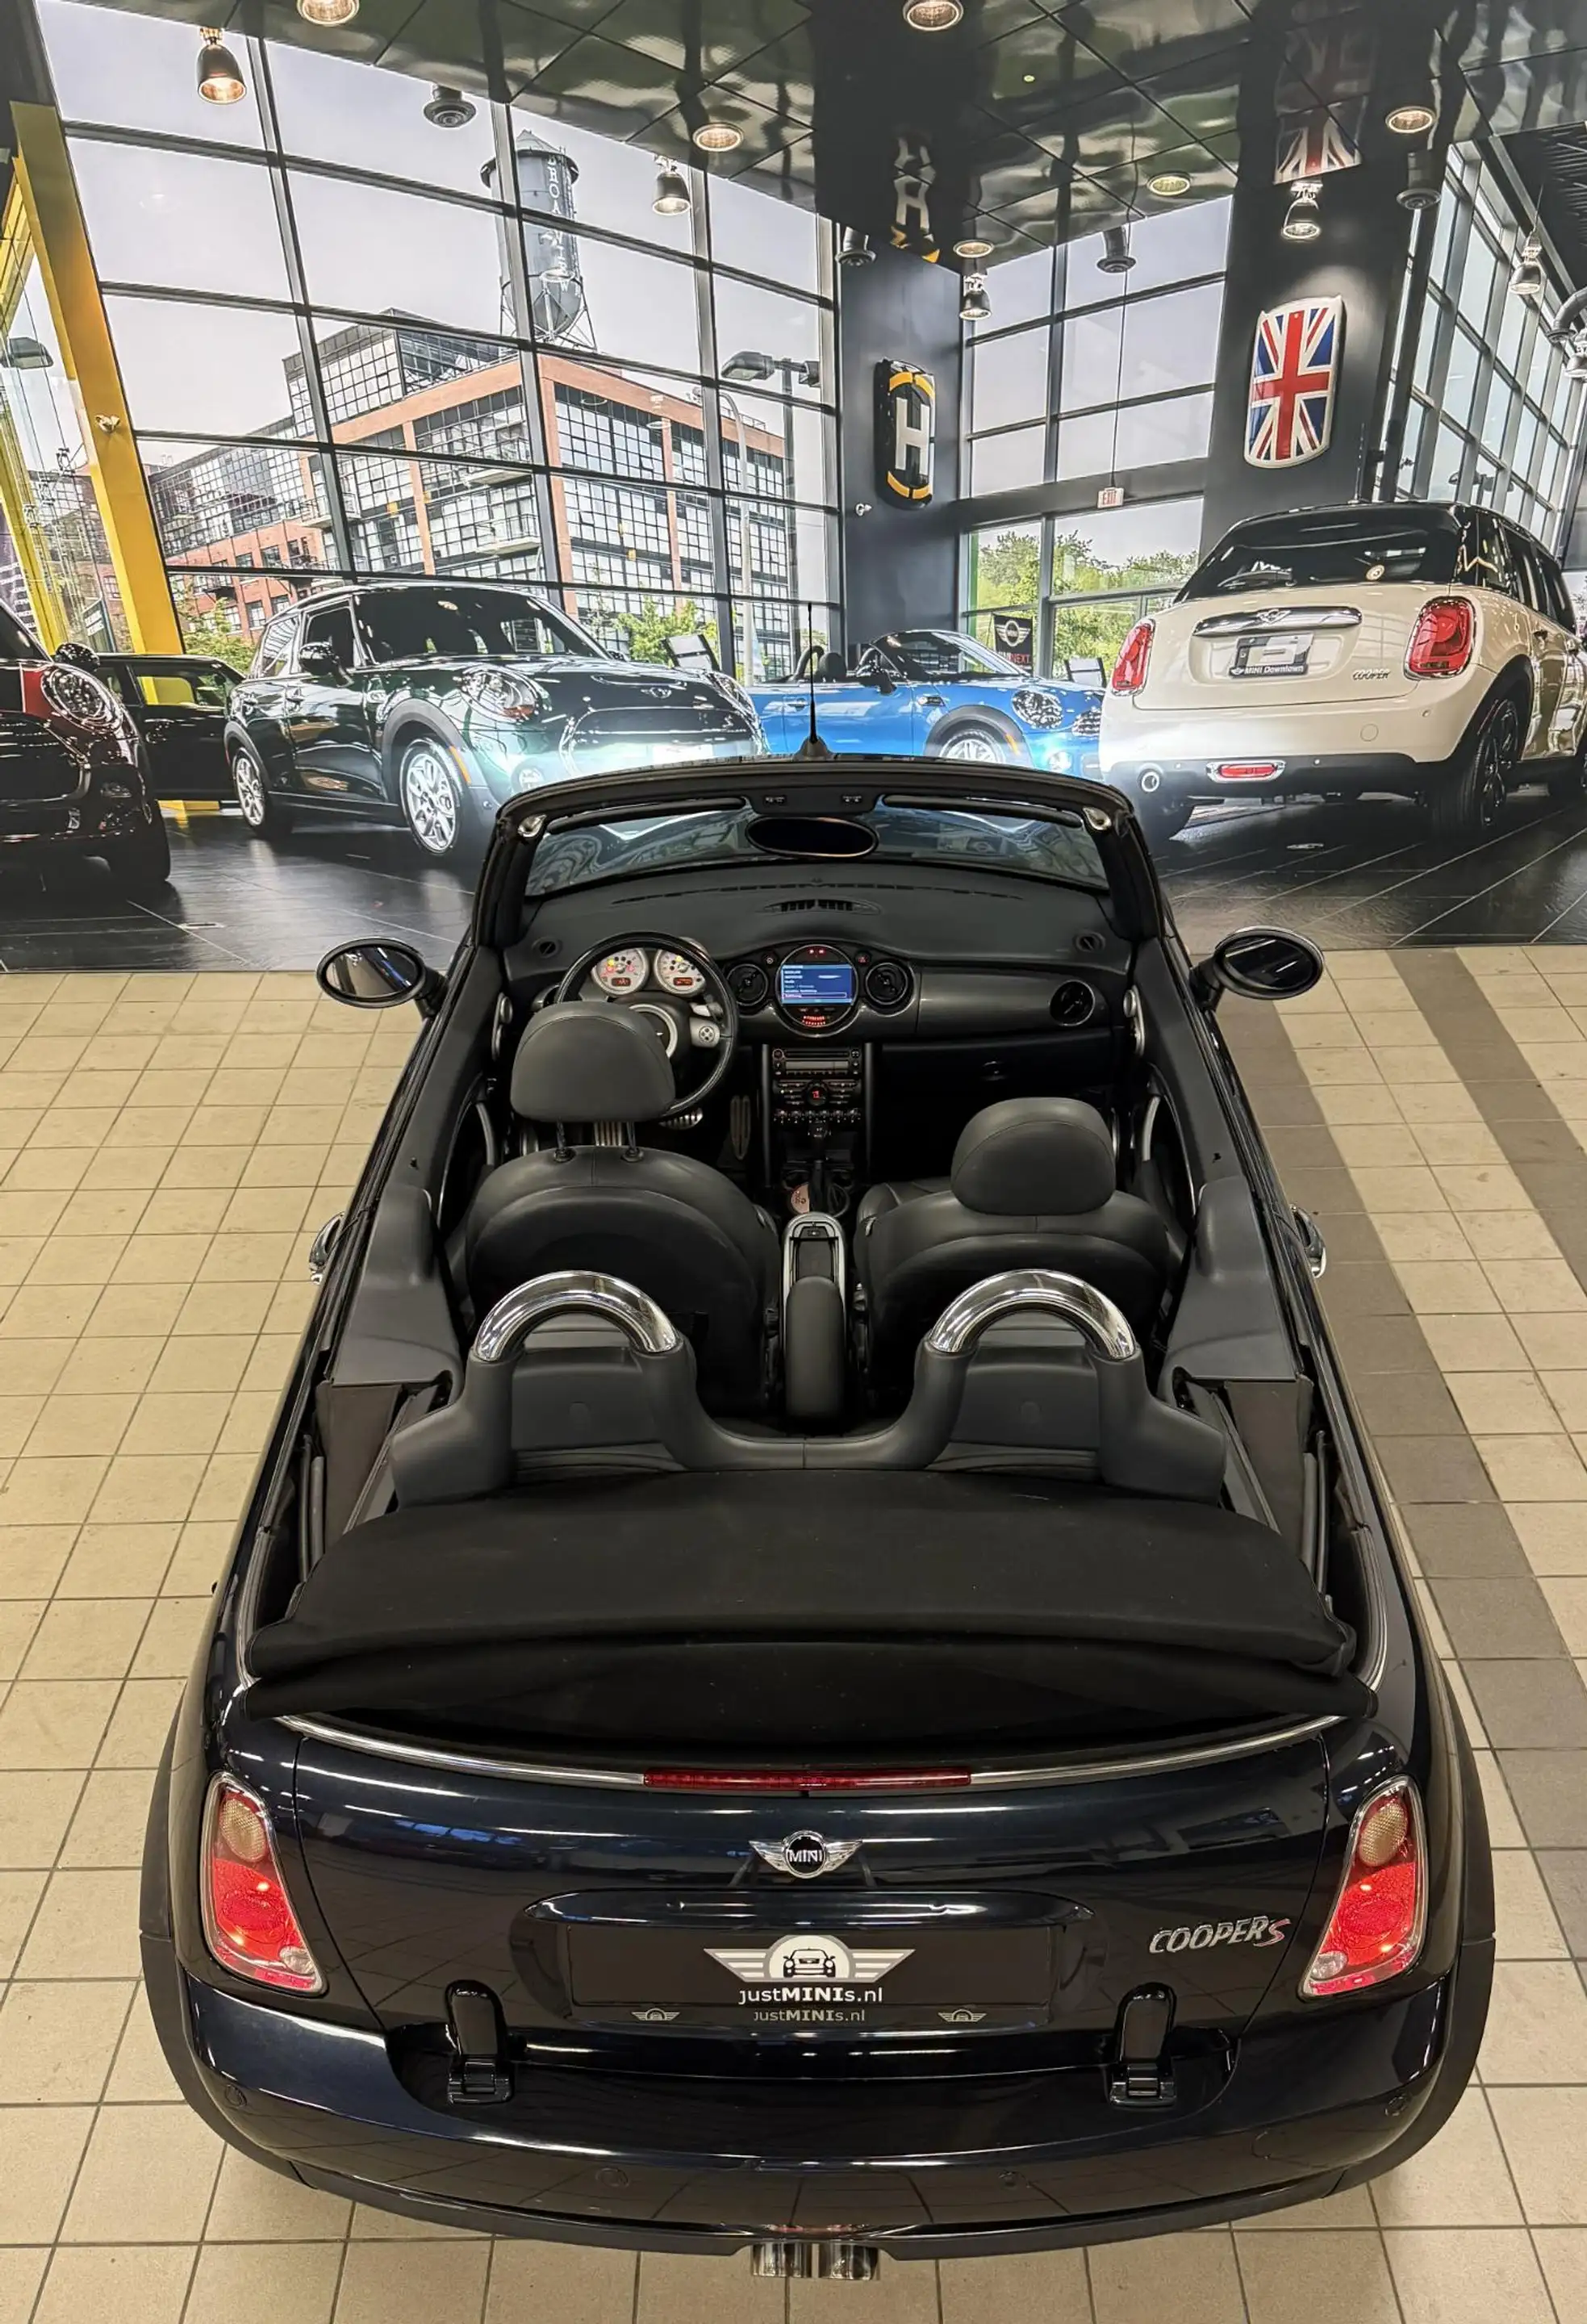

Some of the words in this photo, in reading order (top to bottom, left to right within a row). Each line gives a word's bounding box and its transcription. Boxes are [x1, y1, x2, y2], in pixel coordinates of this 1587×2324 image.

[1244, 667, 1263, 675] MINI
[1263, 665, 1304, 674] Downtown
[1352, 668, 1391, 681] COOPER
[788, 1849, 823, 1863] MINI
[738, 1987, 883, 2005] justMINIs.nl
[754, 2009, 865, 2021] justMINIs.nl
